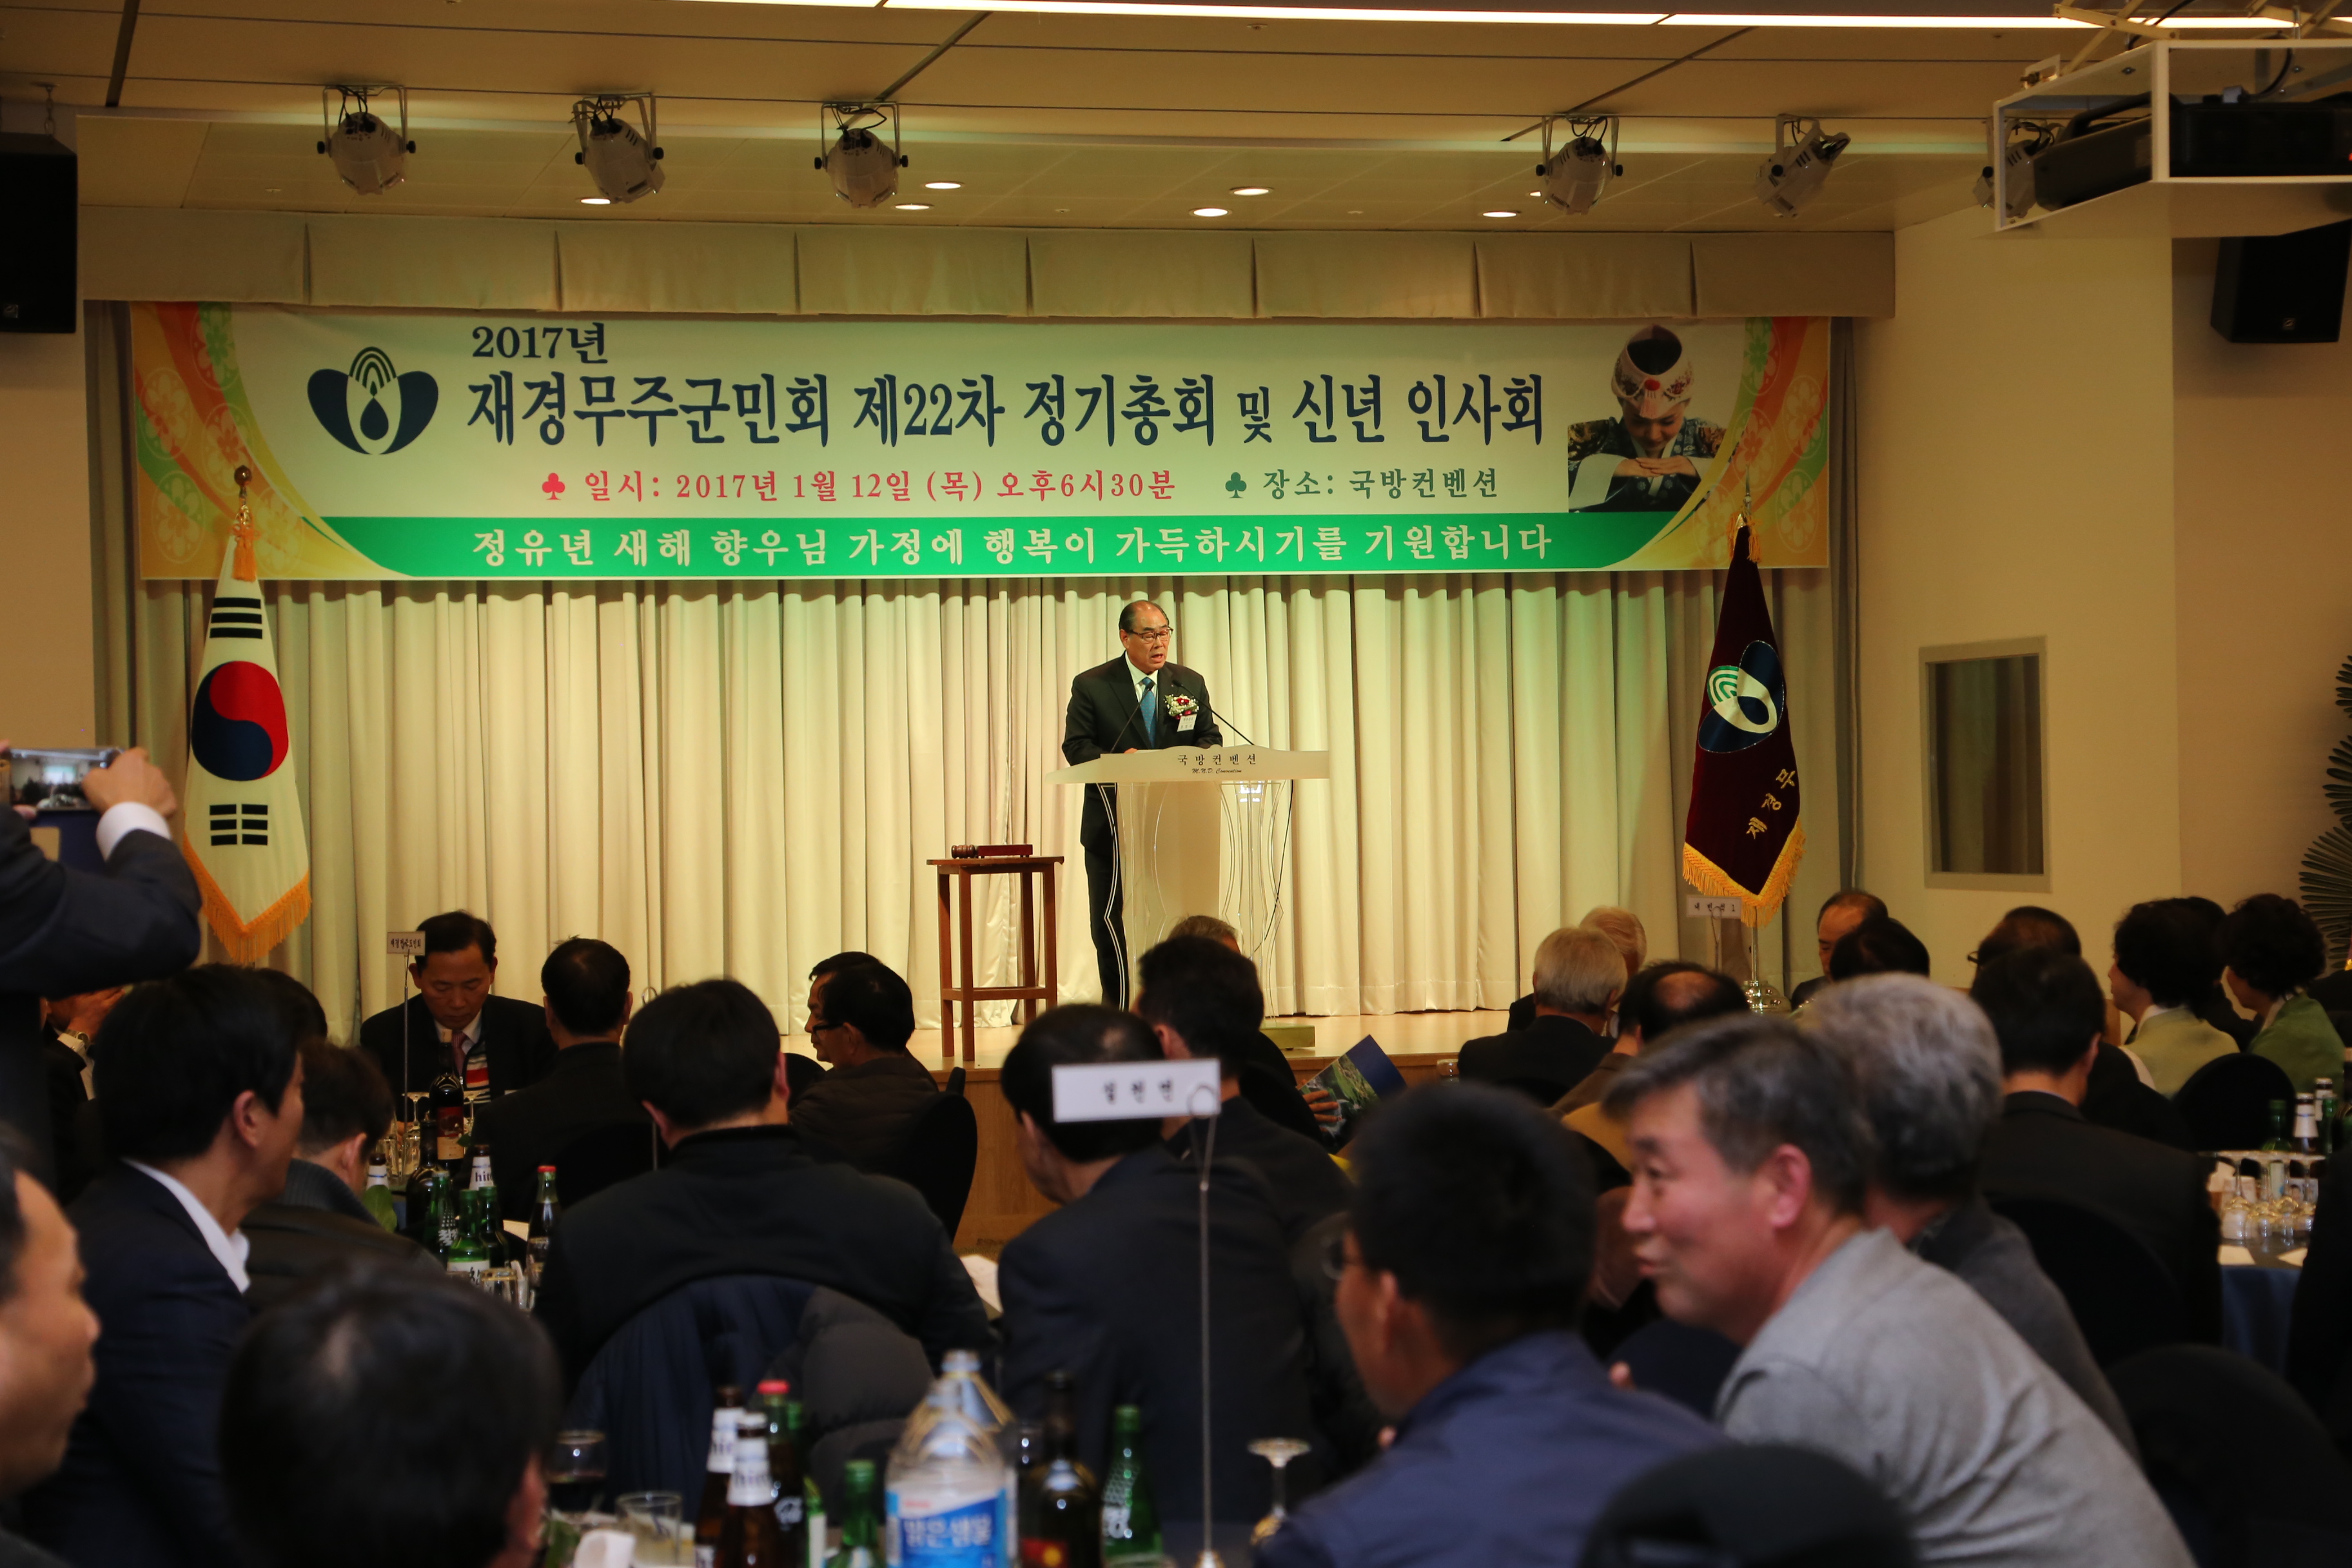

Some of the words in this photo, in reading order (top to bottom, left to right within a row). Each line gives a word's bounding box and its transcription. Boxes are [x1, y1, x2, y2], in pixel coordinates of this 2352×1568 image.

[472, 322, 609, 364] 2017년
[468, 371, 828, 447] 재경무주군민회
[854, 374, 1004, 447] 제22차
[1024, 374, 1213, 446] 정기총회
[1237, 386, 1271, 443] 및
[1293, 375, 1384, 442] 신년
[1408, 374, 1542, 445] 인사회
[585, 471, 660, 502] 일시:
[677, 471, 777, 501] 2017년
[796, 471, 836, 501] 1월
[852, 471, 910, 501] 12일
[928, 472, 981, 501] (목)
[997, 470, 1175, 501] 오후6시30분
[1264, 469, 1333, 499] 장소:
[1349, 468, 1496, 499] 국방컨벤션
[473, 529, 593, 567] 정유년
[614, 529, 690, 566] 새해
[711, 529, 825, 566] 향우님
[849, 529, 962, 565] 가정에
[984, 527, 1093, 564] 행복이
[1117, 526, 1346, 563] 가득하시기를
[1366, 524, 1551, 560] 기원합니다
[1177, 753, 1257, 766] 국방컨벤션
